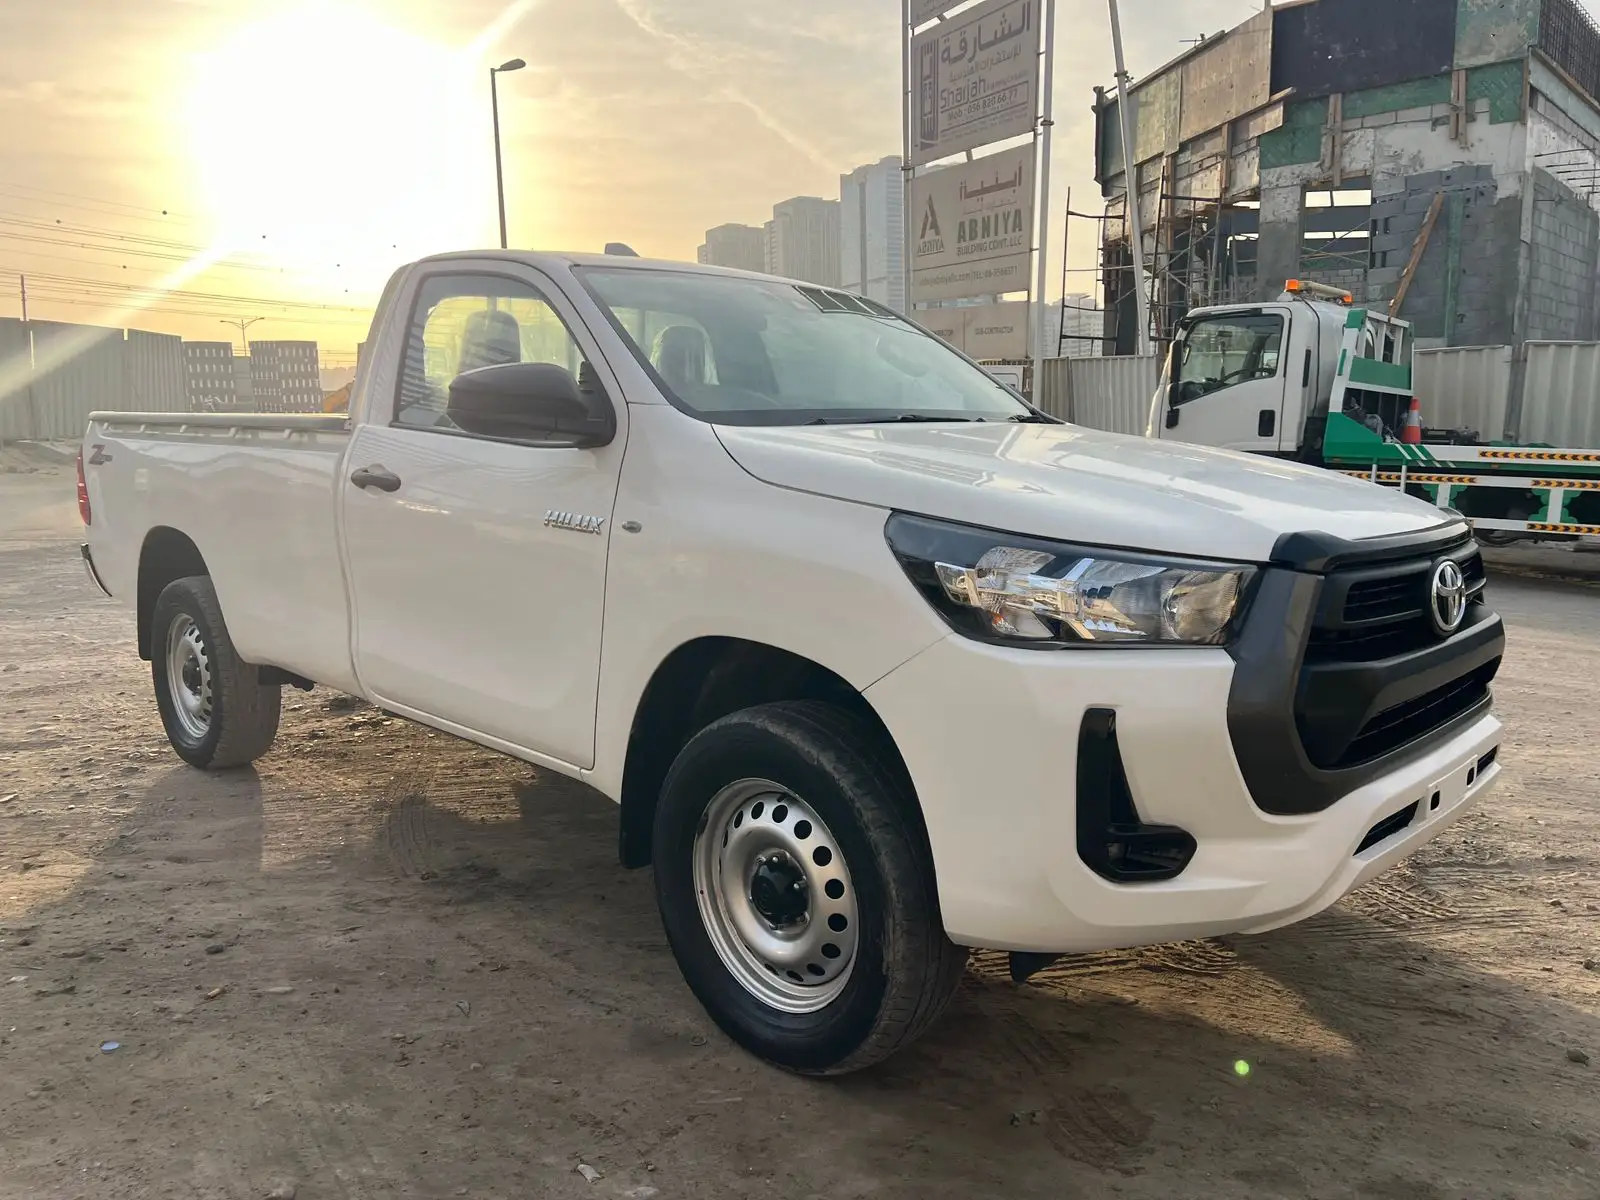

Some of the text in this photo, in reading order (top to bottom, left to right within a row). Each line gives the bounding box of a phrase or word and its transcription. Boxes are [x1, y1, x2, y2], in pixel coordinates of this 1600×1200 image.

[940, 1, 1031, 64] الشارقة
[940, 76, 987, 109] Sharjah
[957, 208, 1023, 244] ABNIYA
[917, 238, 945, 254] ABNIYA
[544, 510, 605, 535] HILUX
